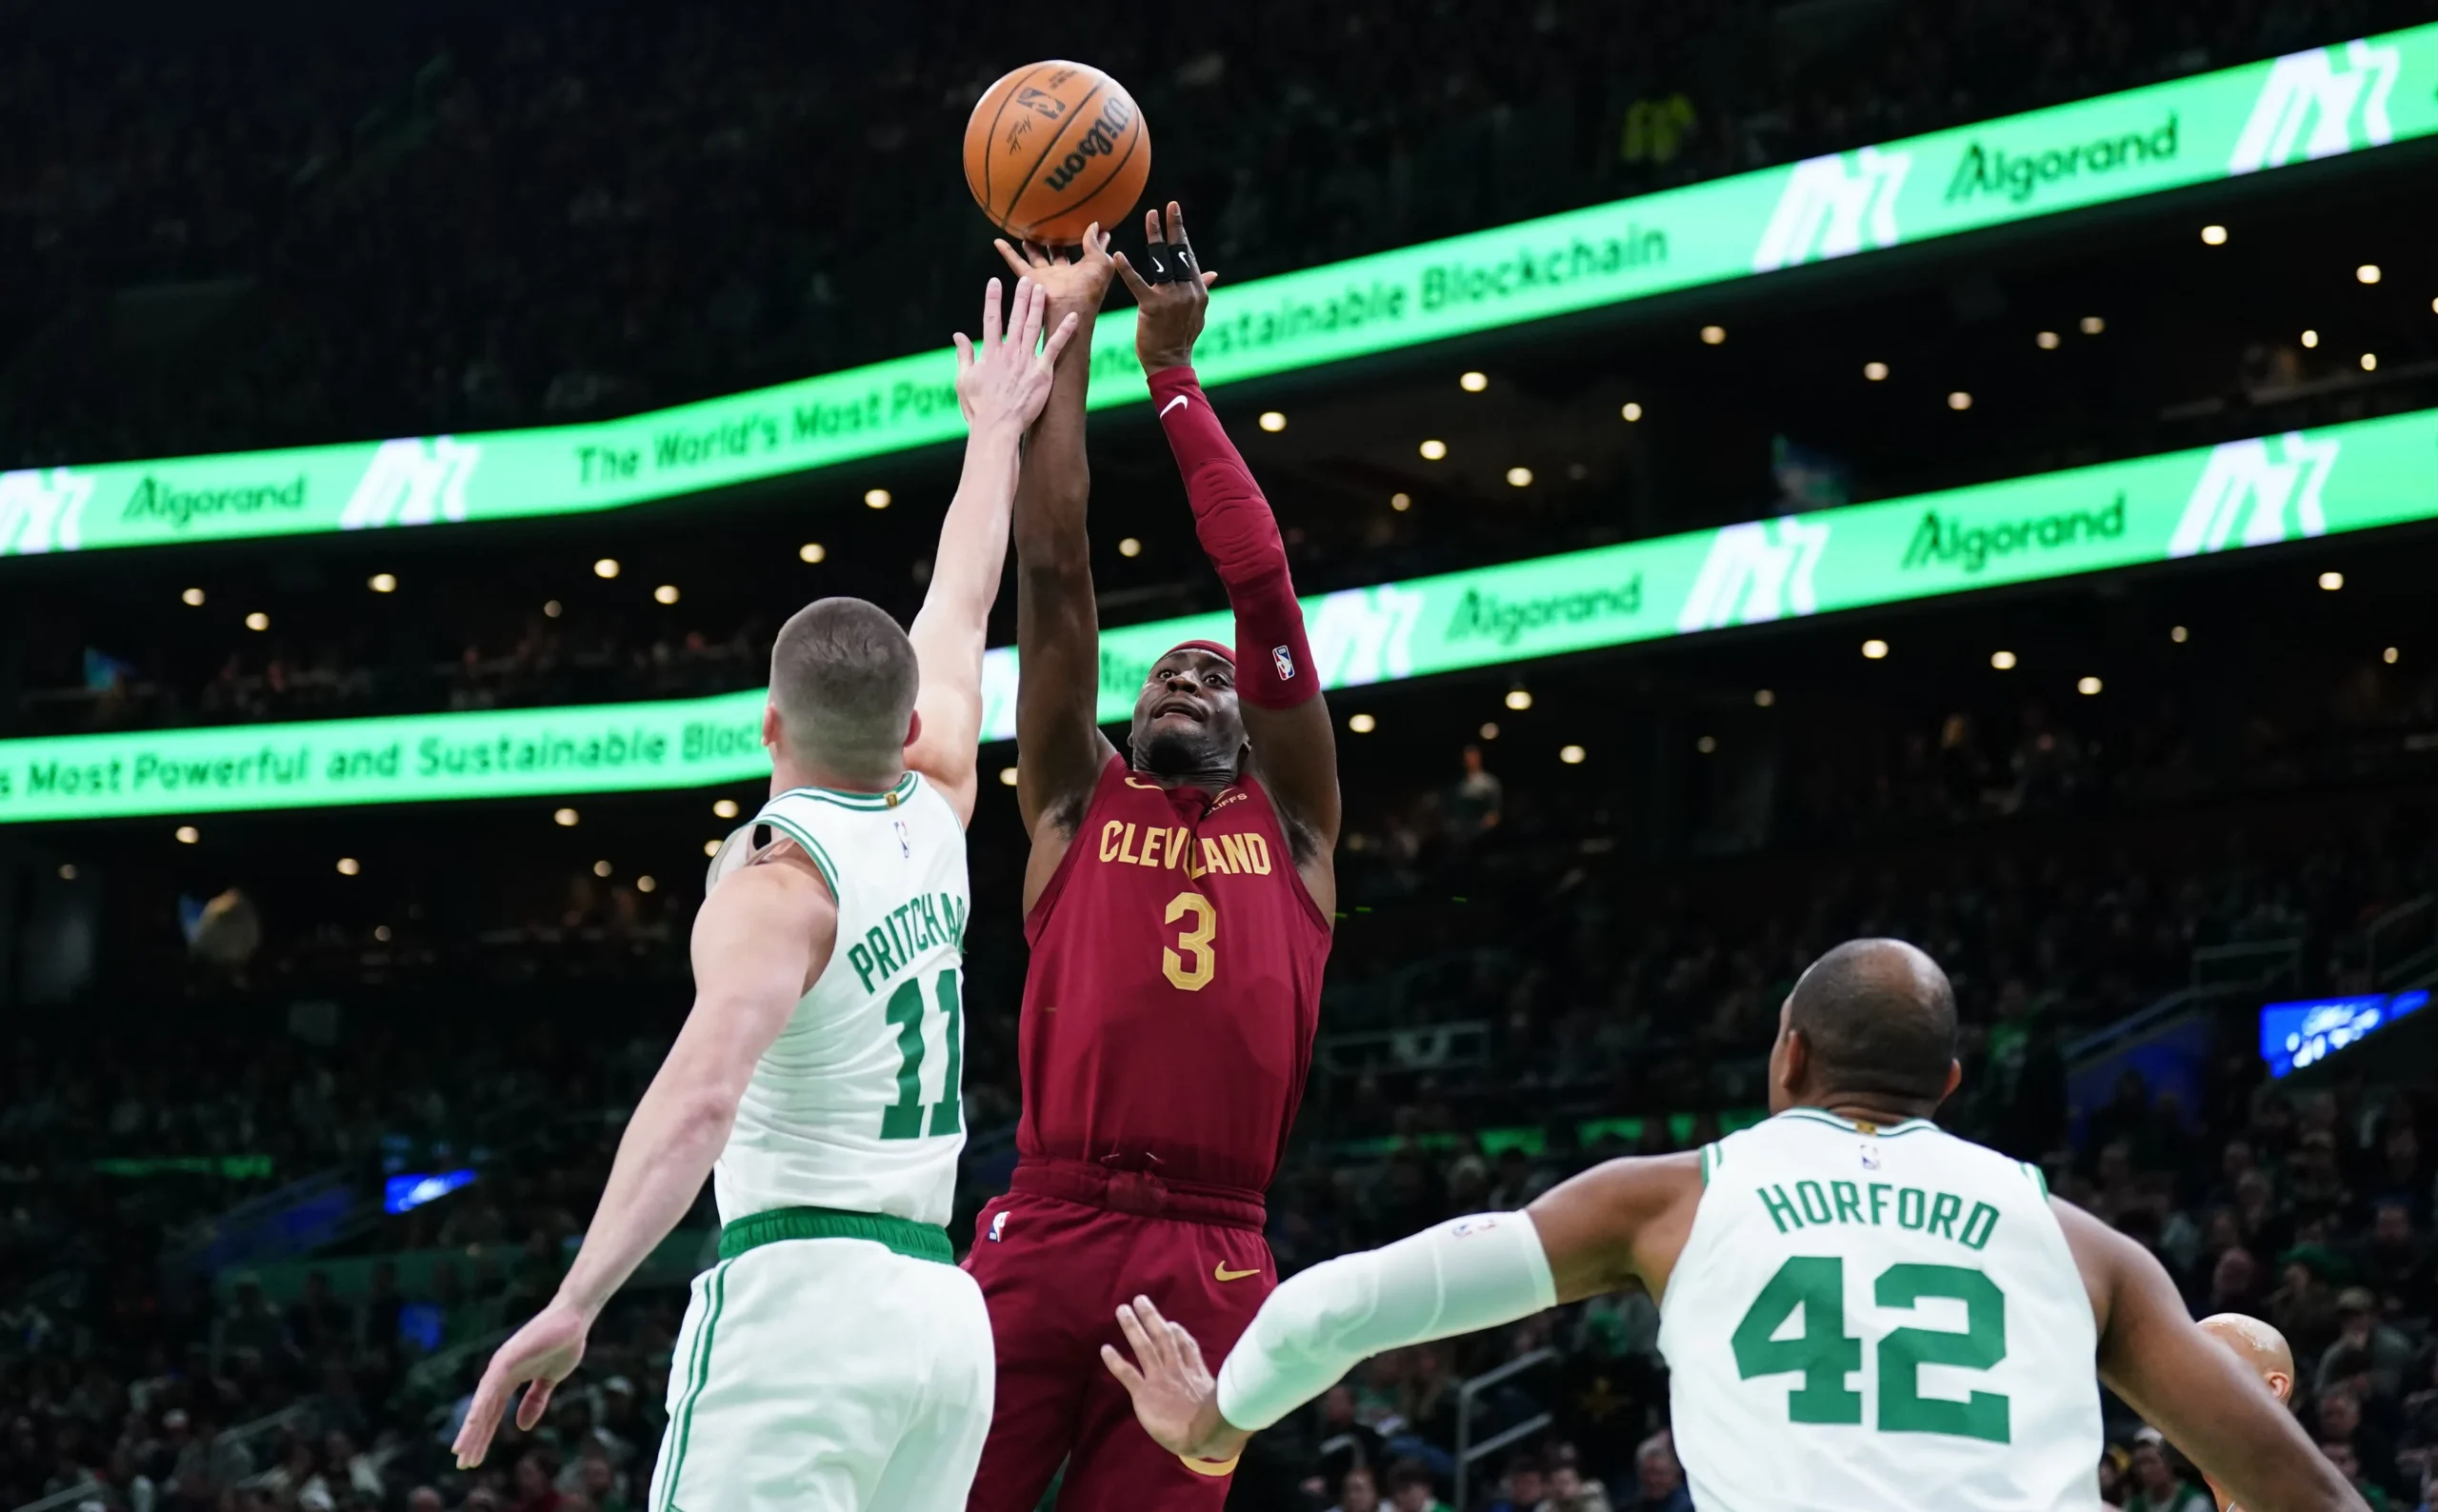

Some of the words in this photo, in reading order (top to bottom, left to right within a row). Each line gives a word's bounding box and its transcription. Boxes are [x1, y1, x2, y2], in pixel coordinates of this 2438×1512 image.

[1045, 97, 1131, 191] Wilson
[1944, 109, 2179, 204] Algorand
[575, 444, 639, 485] The
[653, 412, 779, 468] World's
[792, 391, 884, 443] Most
[1419, 221, 1668, 313] Blockchain
[121, 475, 307, 527] Algorand
[1901, 490, 2125, 571] Algorand
[1445, 573, 1642, 646] Algorand
[28, 756, 121, 796] Most
[133, 746, 309, 790] Powerful
[326, 742, 400, 781] and
[417, 726, 667, 777] Sustainable
[1162, 892, 1216, 991] 3
[879, 968, 962, 1140] 11
[1756, 1180, 2000, 1251] HORFORD
[1730, 1256, 2010, 1444] 42
